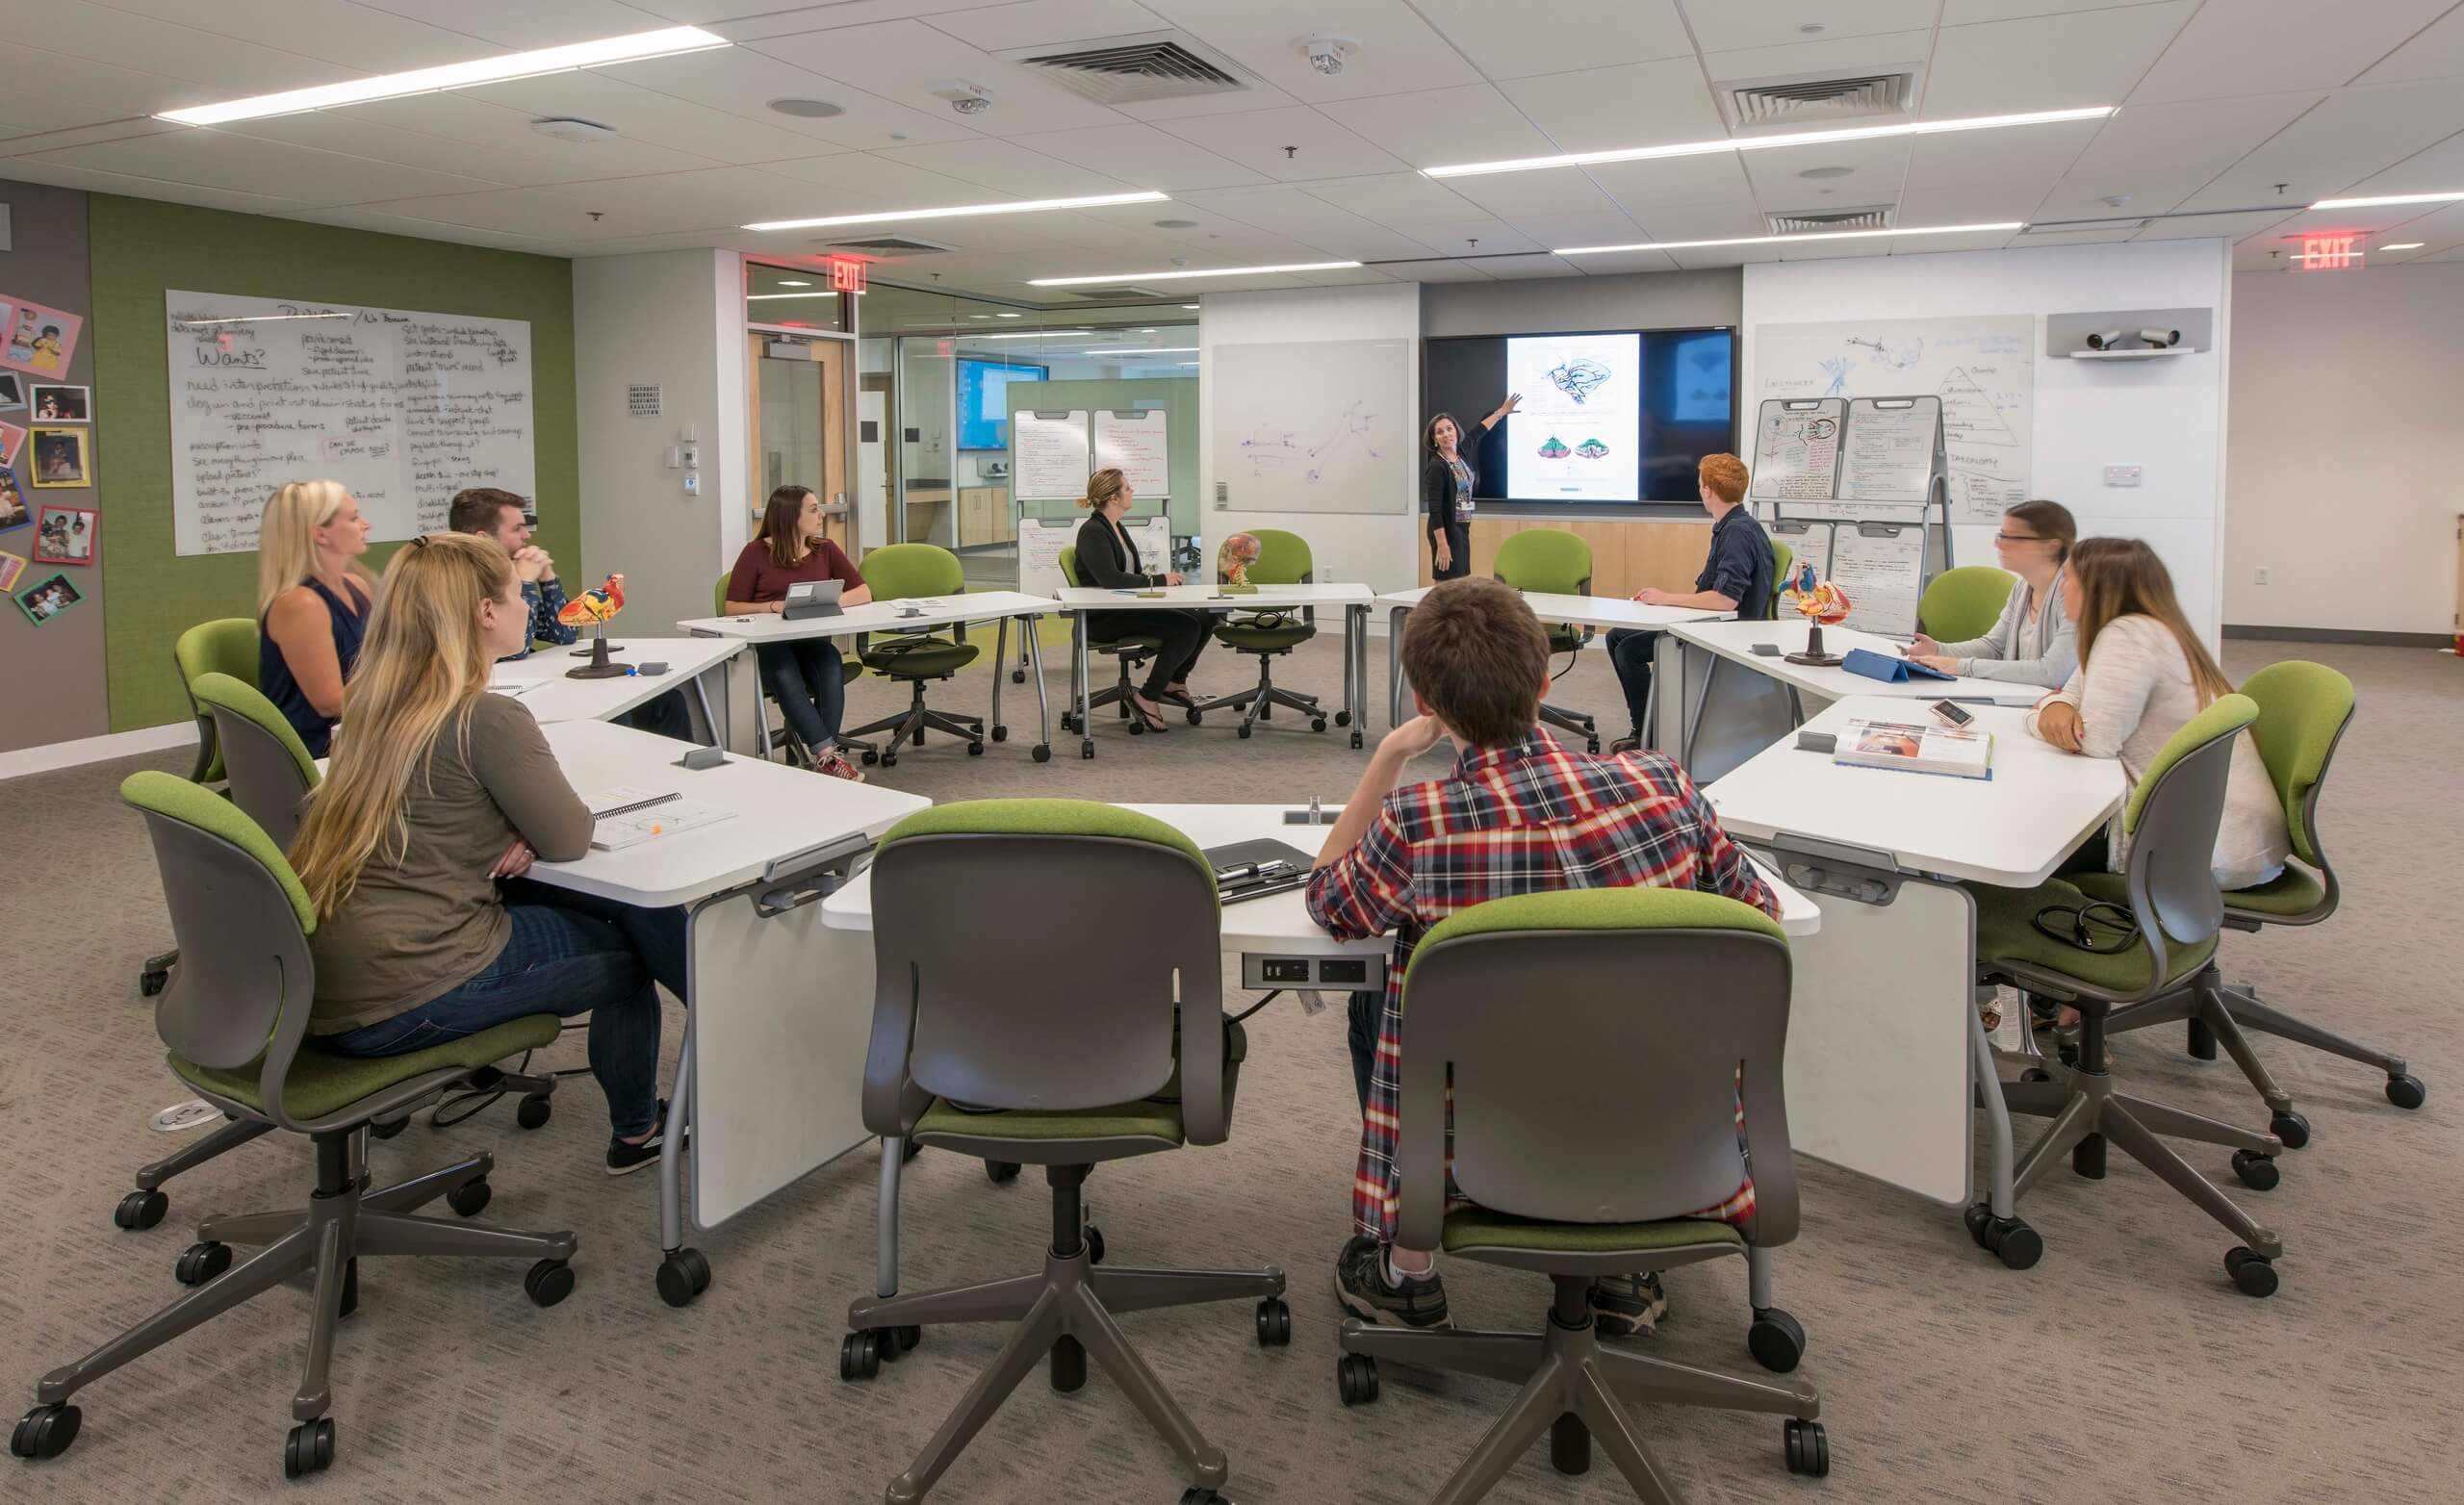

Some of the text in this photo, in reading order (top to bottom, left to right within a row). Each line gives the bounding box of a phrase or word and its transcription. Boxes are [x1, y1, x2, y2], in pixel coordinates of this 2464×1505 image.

[2303, 237, 2354, 269] EXIT
[834, 260, 860, 291] EXIT
[195, 347, 267, 367] Wants?
